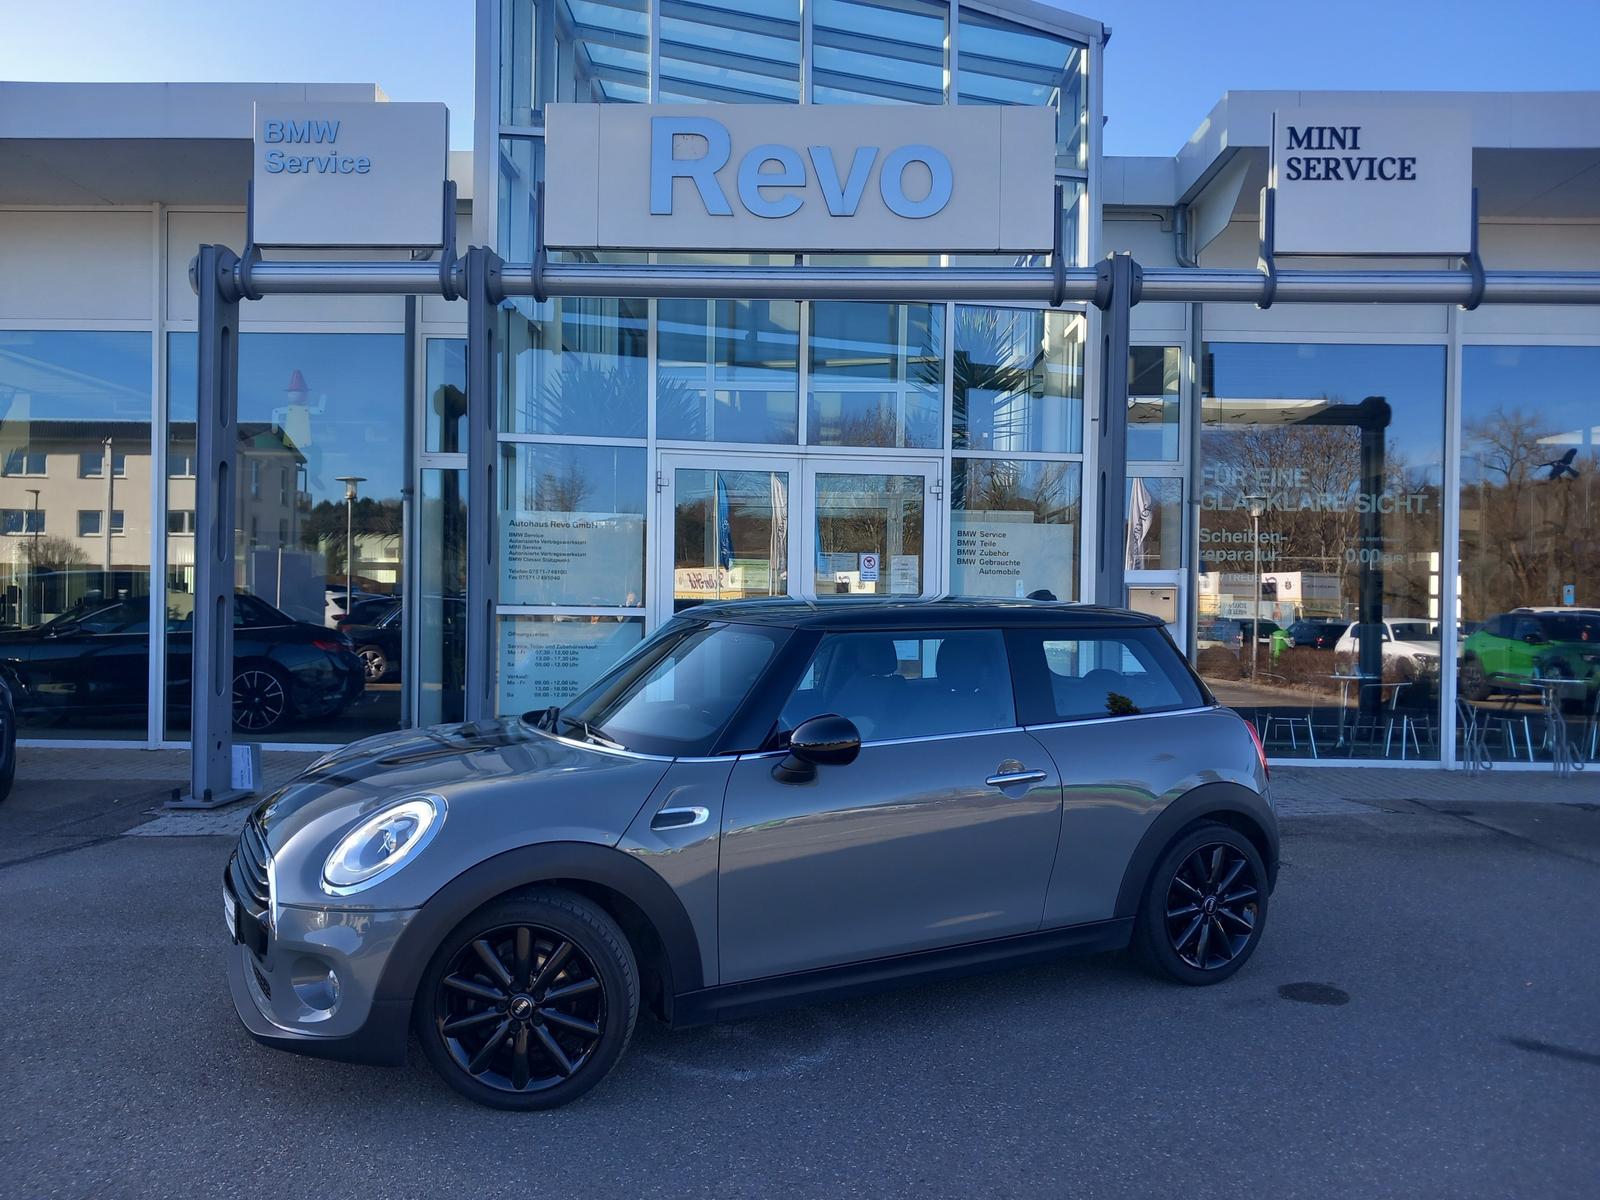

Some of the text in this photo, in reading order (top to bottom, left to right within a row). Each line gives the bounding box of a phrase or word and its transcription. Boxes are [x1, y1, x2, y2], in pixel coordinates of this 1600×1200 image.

[264, 120, 340, 143] BMW
[1286, 126, 1361, 150] MINI
[264, 150, 371, 174] Service
[650, 116, 953, 219] Revo
[1286, 157, 1416, 181] SERVICE
[1256, 468, 1311, 488] EINE
[509, 519, 598, 529] Autohaus Revo GmbH
[1199, 528, 1288, 544] Scheiben-
[979, 549, 1010, 557] Zubehör
[979, 568, 1021, 576] Automobile
